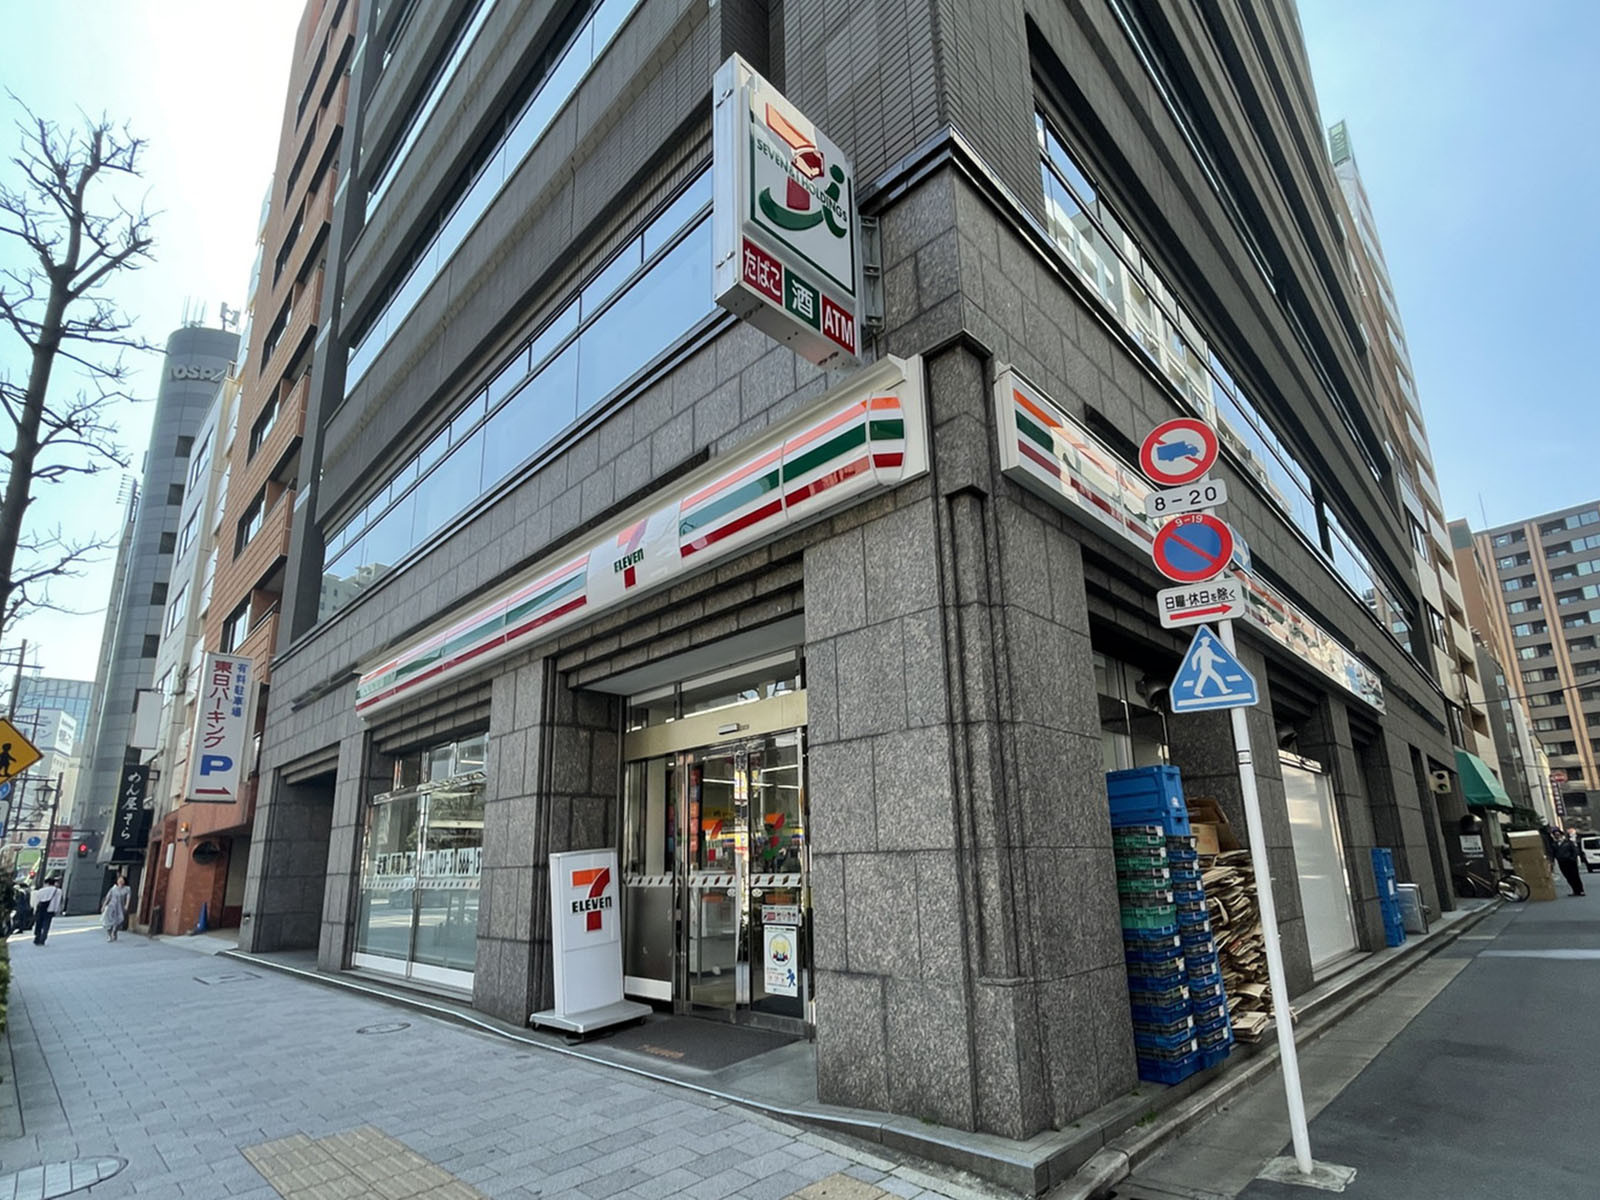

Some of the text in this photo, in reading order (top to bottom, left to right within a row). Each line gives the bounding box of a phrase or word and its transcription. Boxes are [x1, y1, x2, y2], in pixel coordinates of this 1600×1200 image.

[801, 177, 848, 222] HOLDINGS
[744, 248, 781, 297] たばこ
[791, 278, 815, 319] 酒
[824, 303, 854, 347] ATM
[1175, 514, 1203, 526] 9-19
[203, 660, 233, 749] 東日パーキング
[231, 663, 248, 718] 有料駐車場
[200, 754, 233, 776] P
